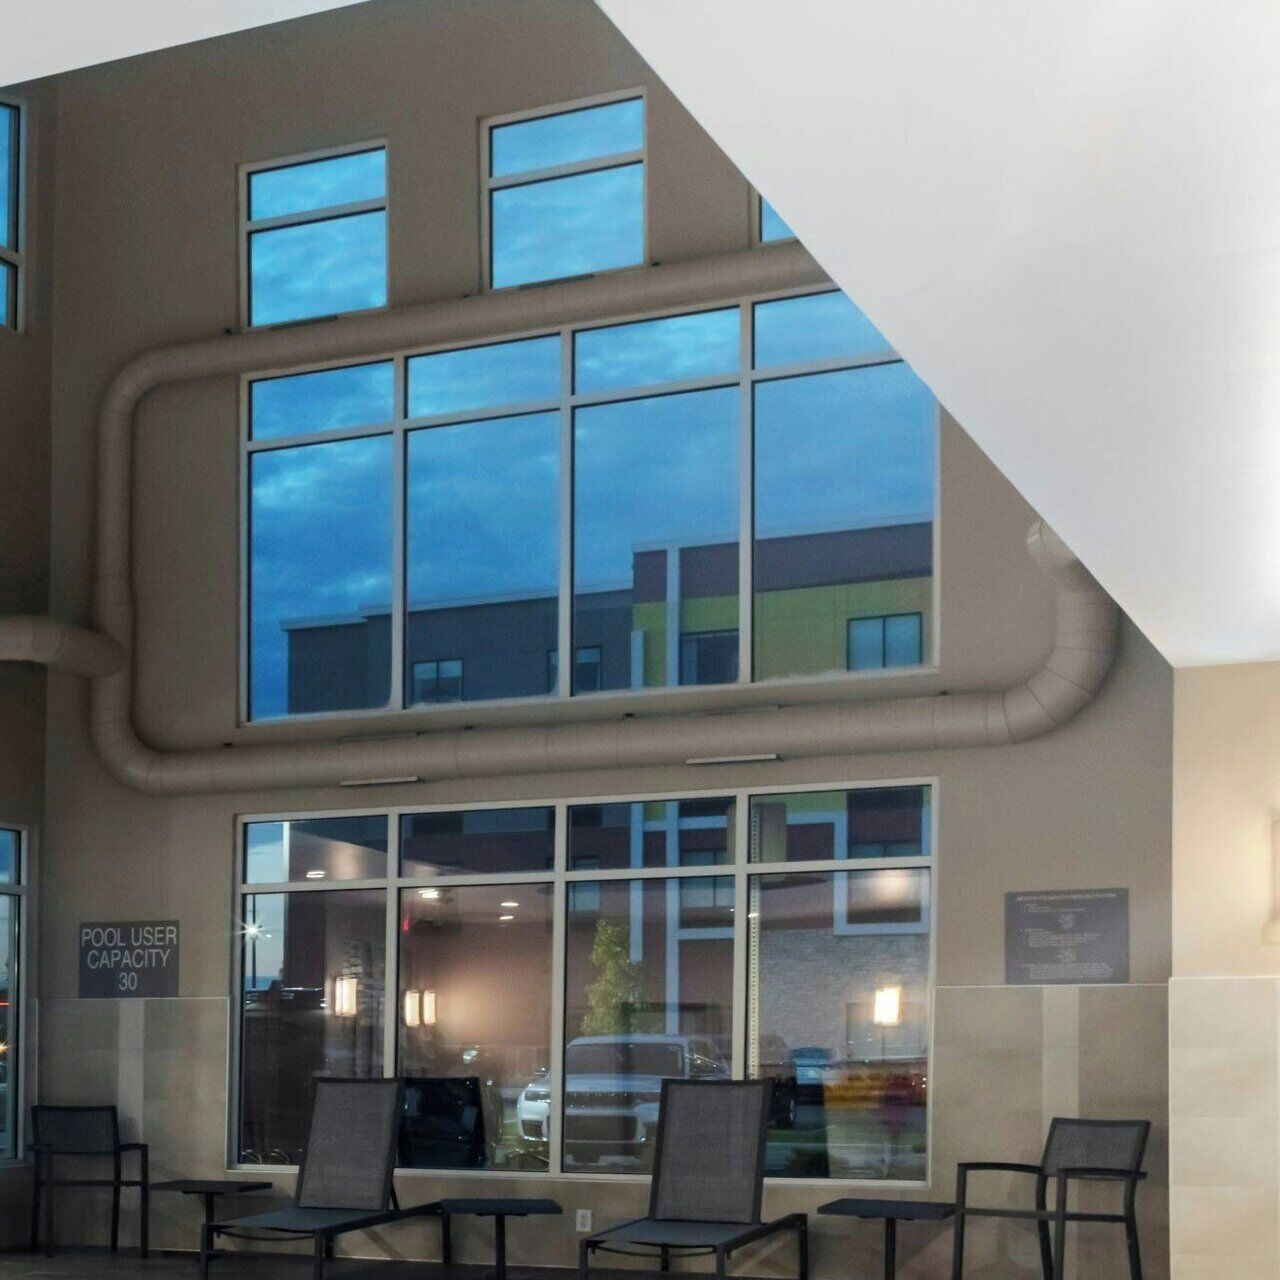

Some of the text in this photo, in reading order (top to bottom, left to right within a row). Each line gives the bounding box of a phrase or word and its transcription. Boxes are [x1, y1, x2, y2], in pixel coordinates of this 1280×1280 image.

[81, 926, 177, 947] POOL USER
[87, 949, 170, 969] CAPACITY
[118, 972, 138, 991] 30
